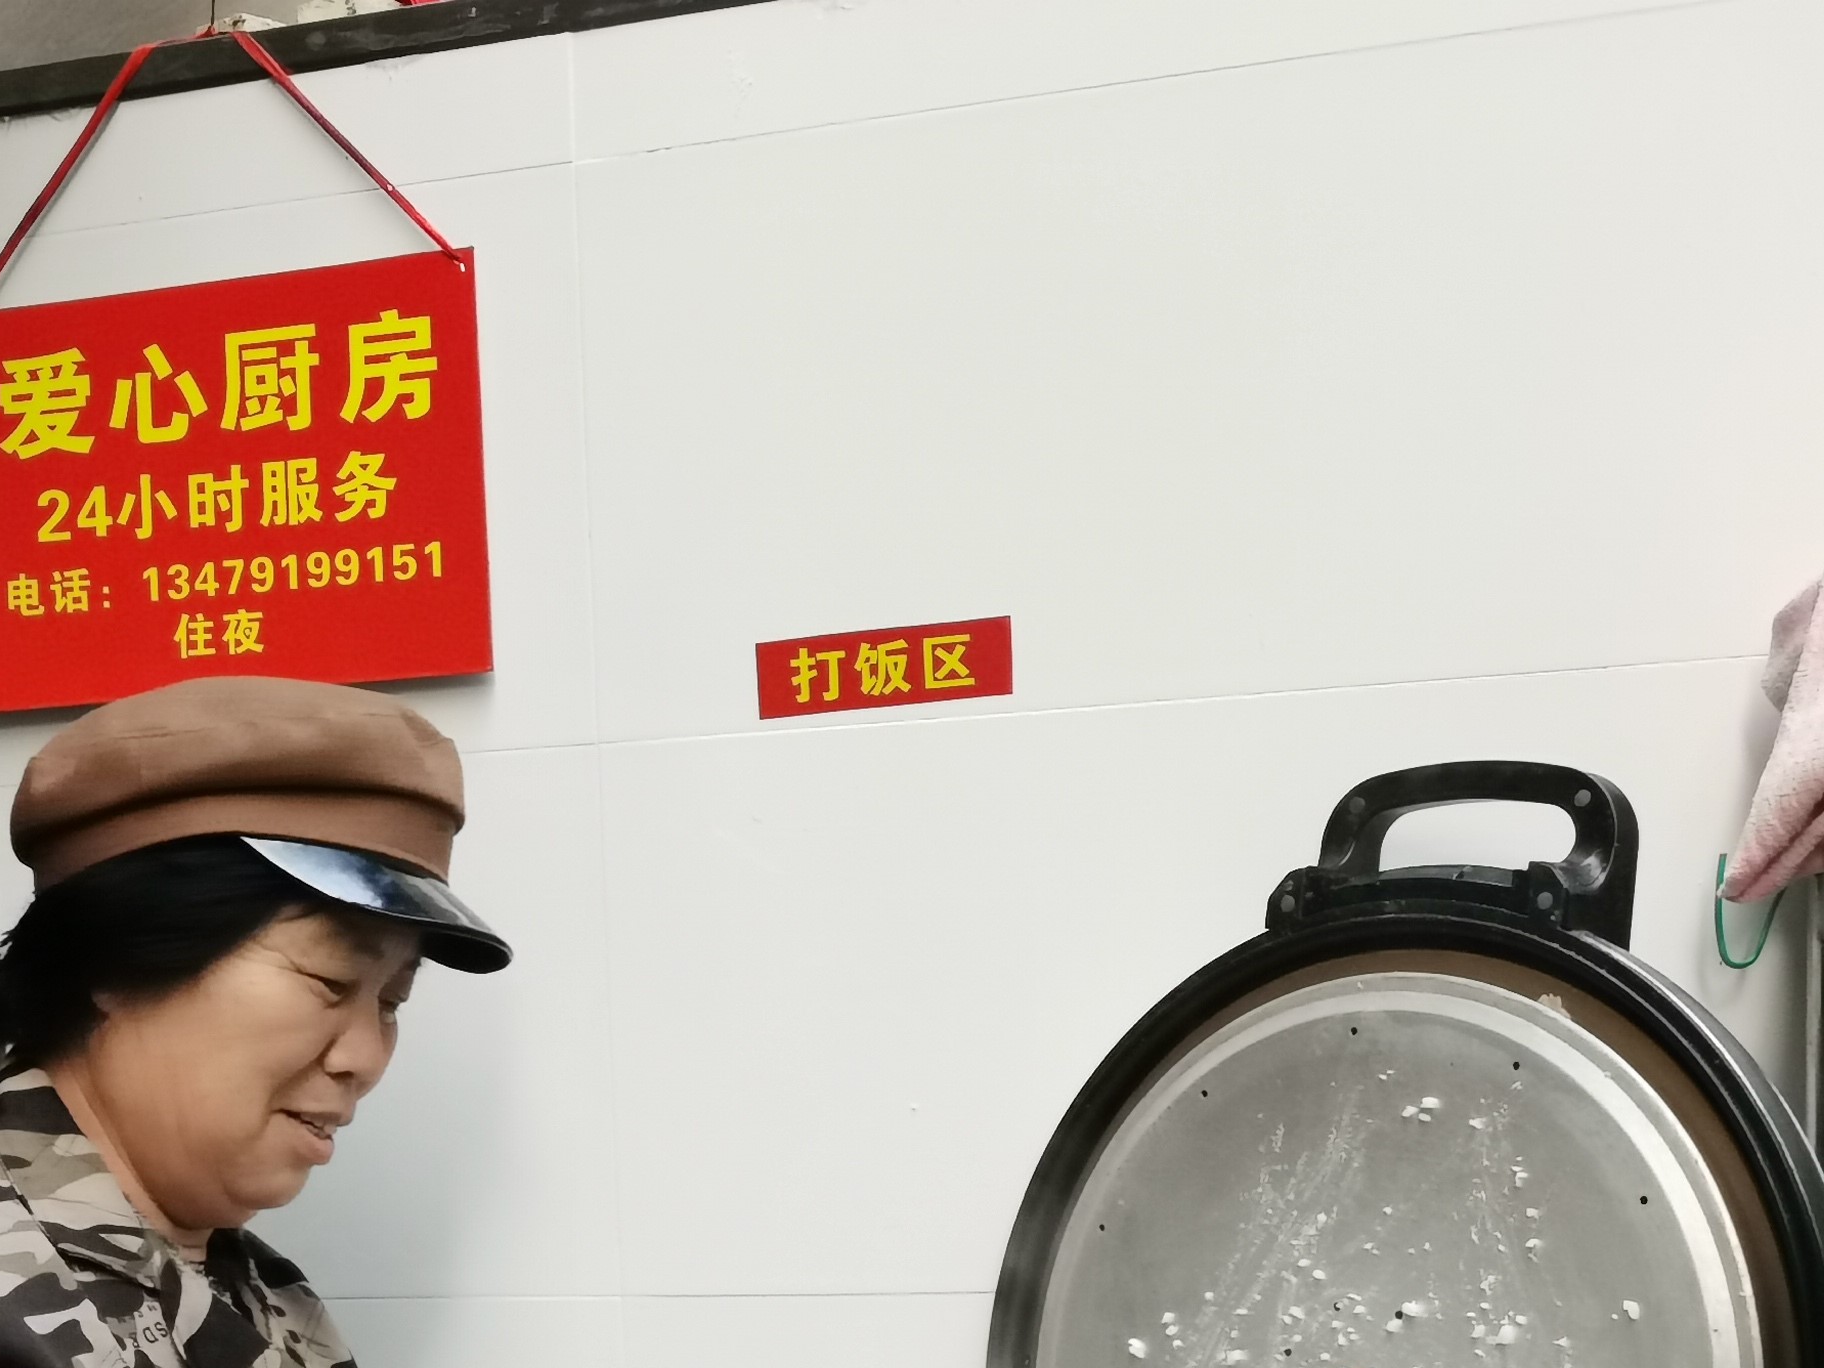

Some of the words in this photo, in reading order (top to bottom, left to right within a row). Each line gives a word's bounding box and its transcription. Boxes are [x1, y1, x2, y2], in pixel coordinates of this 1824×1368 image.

[0, 309, 437, 459] 爱心厨房
[38, 451, 397, 542] 24小时服务
[143, 542, 441, 601] 13479199151
[174, 609, 264, 658] 住夜
[789, 634, 975, 703] 打饭区
